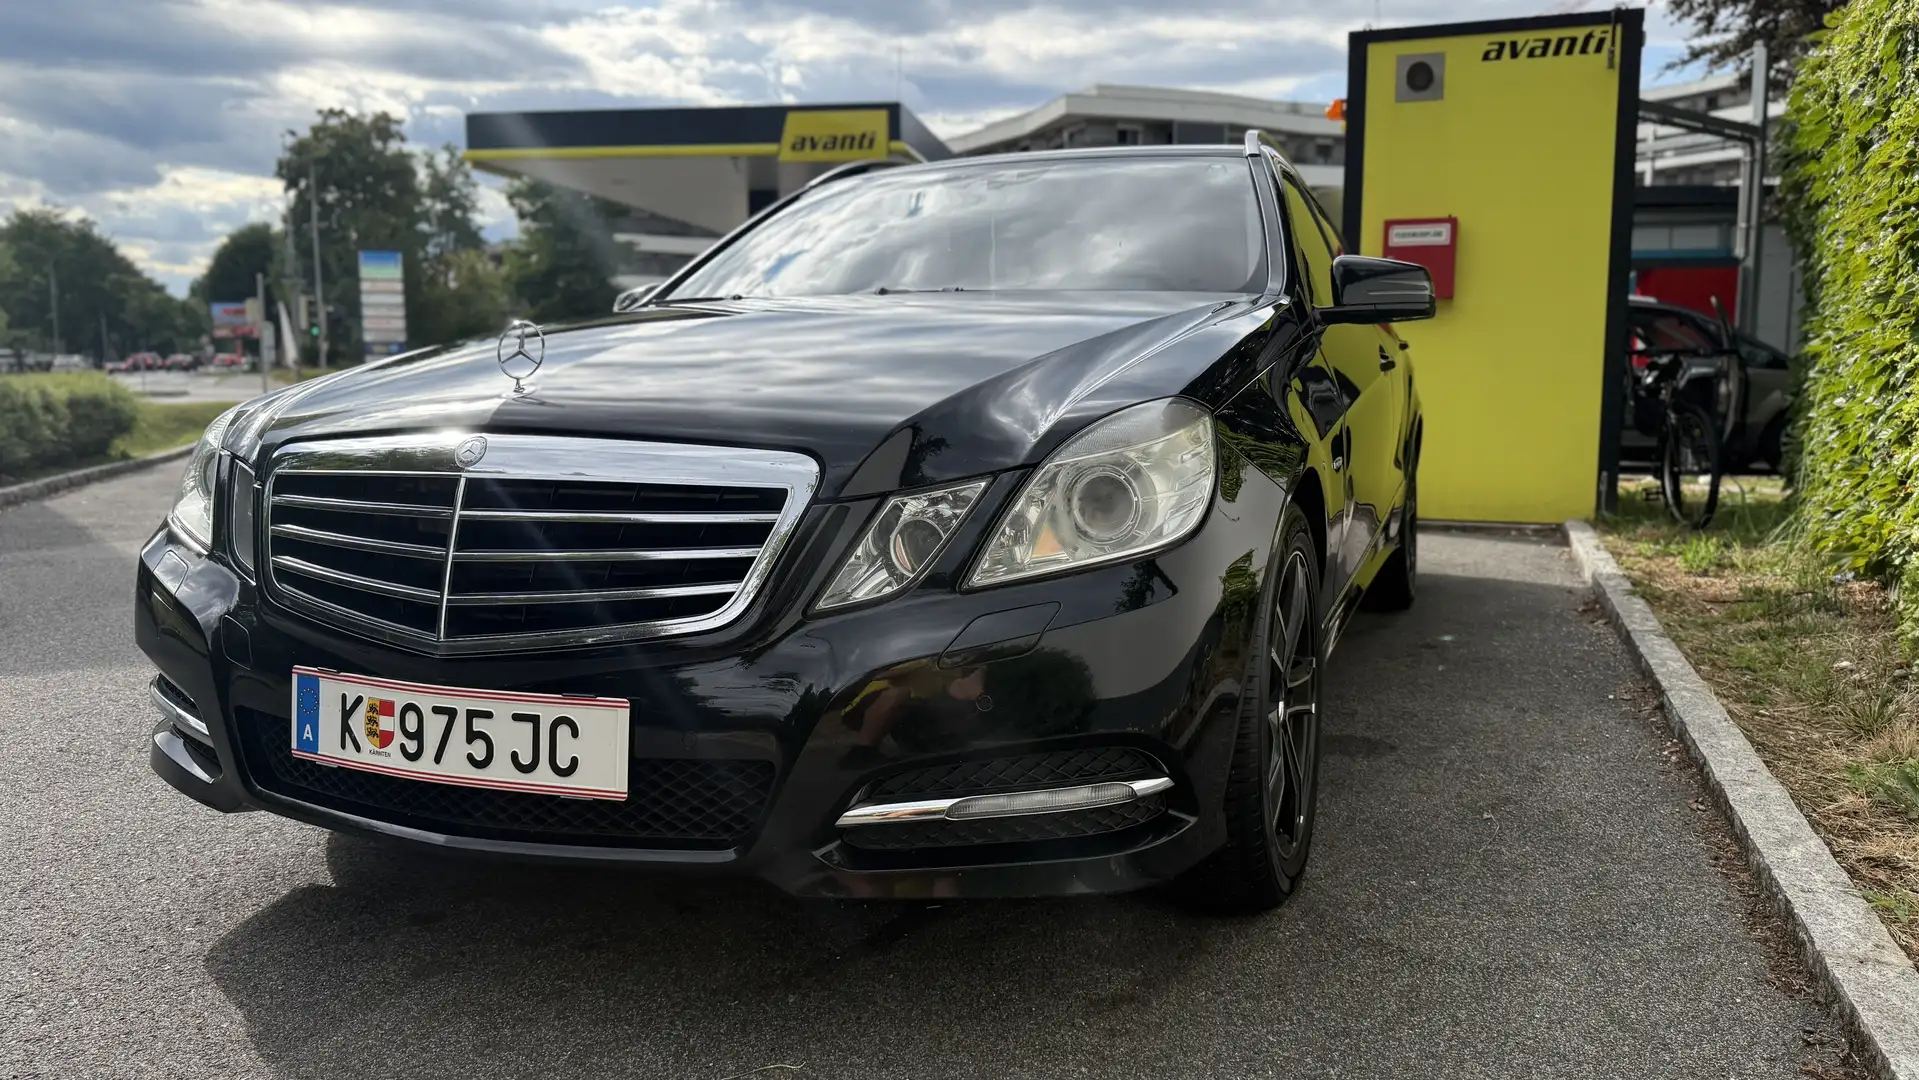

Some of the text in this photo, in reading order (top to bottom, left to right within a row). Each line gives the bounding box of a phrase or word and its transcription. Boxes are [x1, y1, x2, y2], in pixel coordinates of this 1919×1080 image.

[1481, 30, 1609, 62] avanti
[791, 130, 877, 152] avanti
[302, 723, 314, 742] A
[340, 692, 580, 778] K 975 JC
